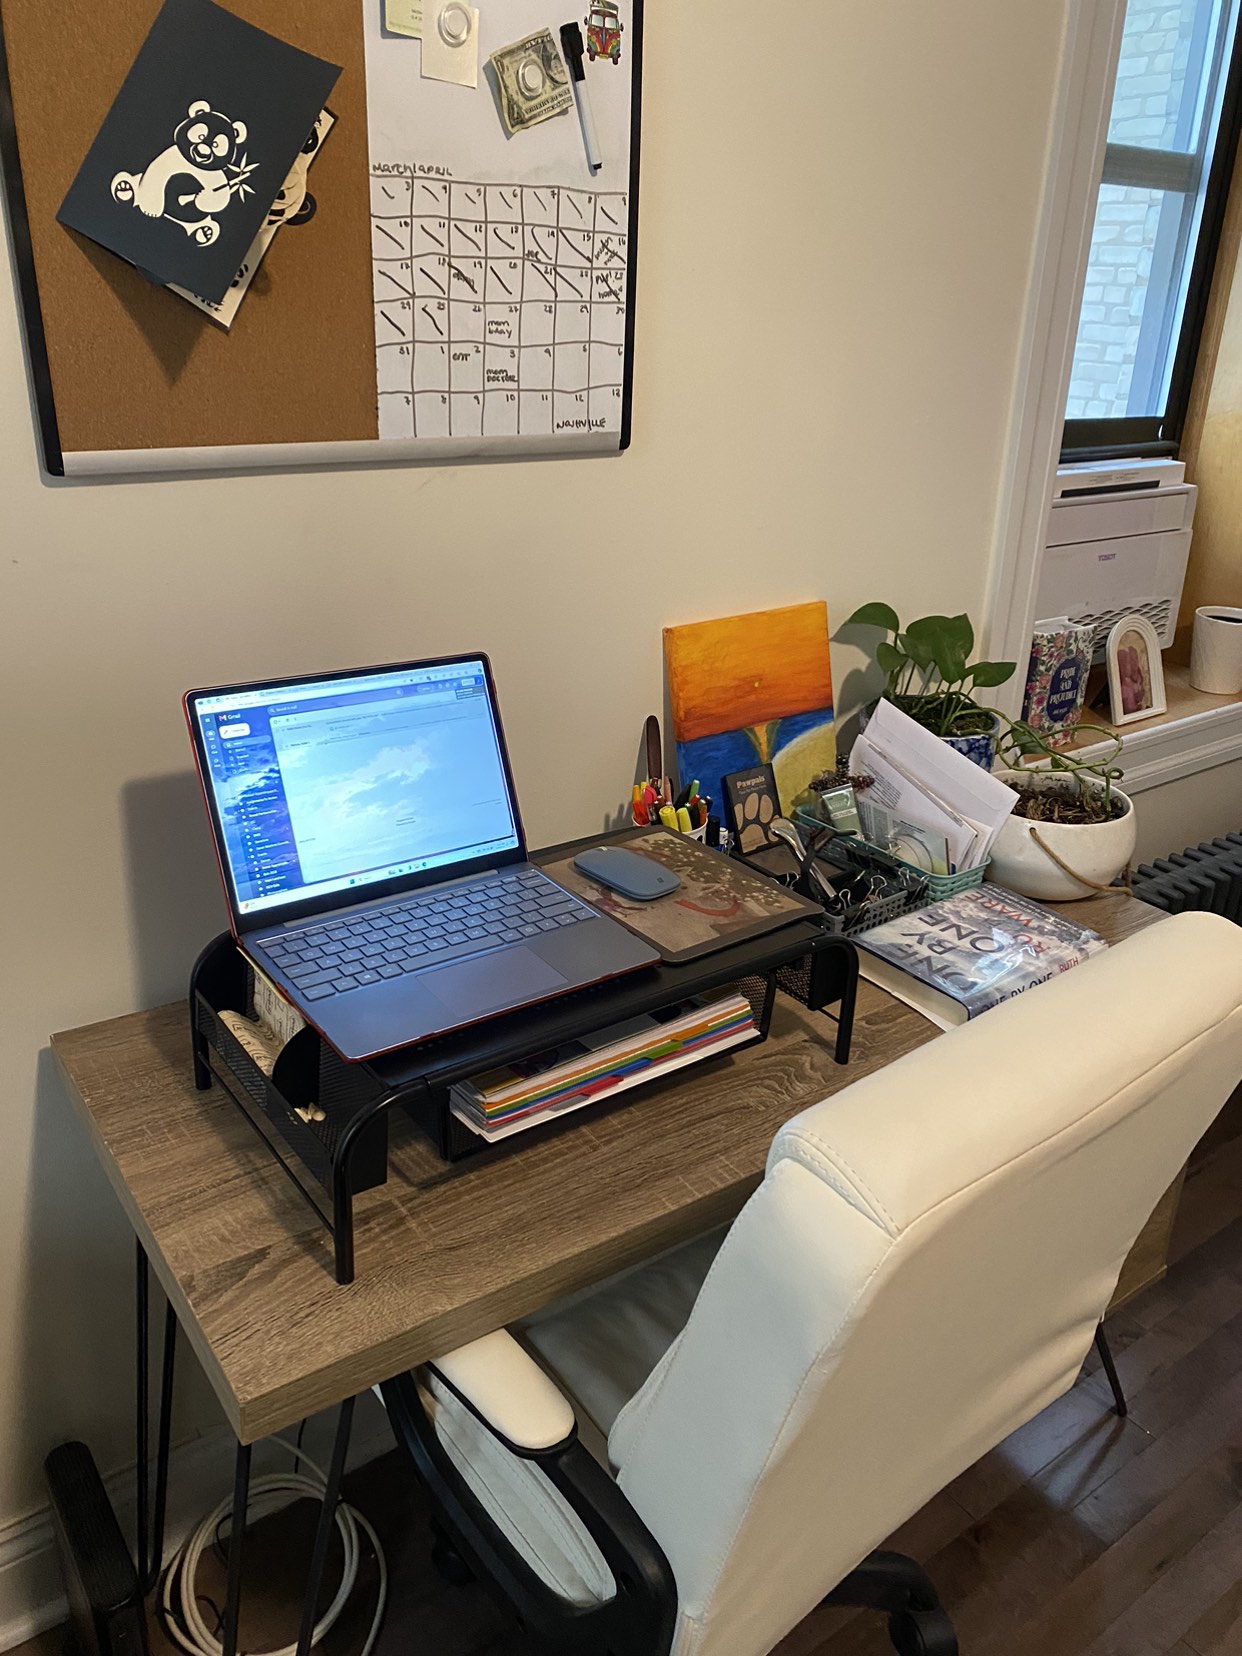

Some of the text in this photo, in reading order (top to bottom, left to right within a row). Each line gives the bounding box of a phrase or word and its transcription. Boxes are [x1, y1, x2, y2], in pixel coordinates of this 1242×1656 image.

[736, 775, 765, 788] Pawpals
[964, 891, 1033, 927] WARE
[901, 930, 959, 956] BY
[918, 913, 1006, 953] ONE
[1059, 956, 1079, 973] RUTH
